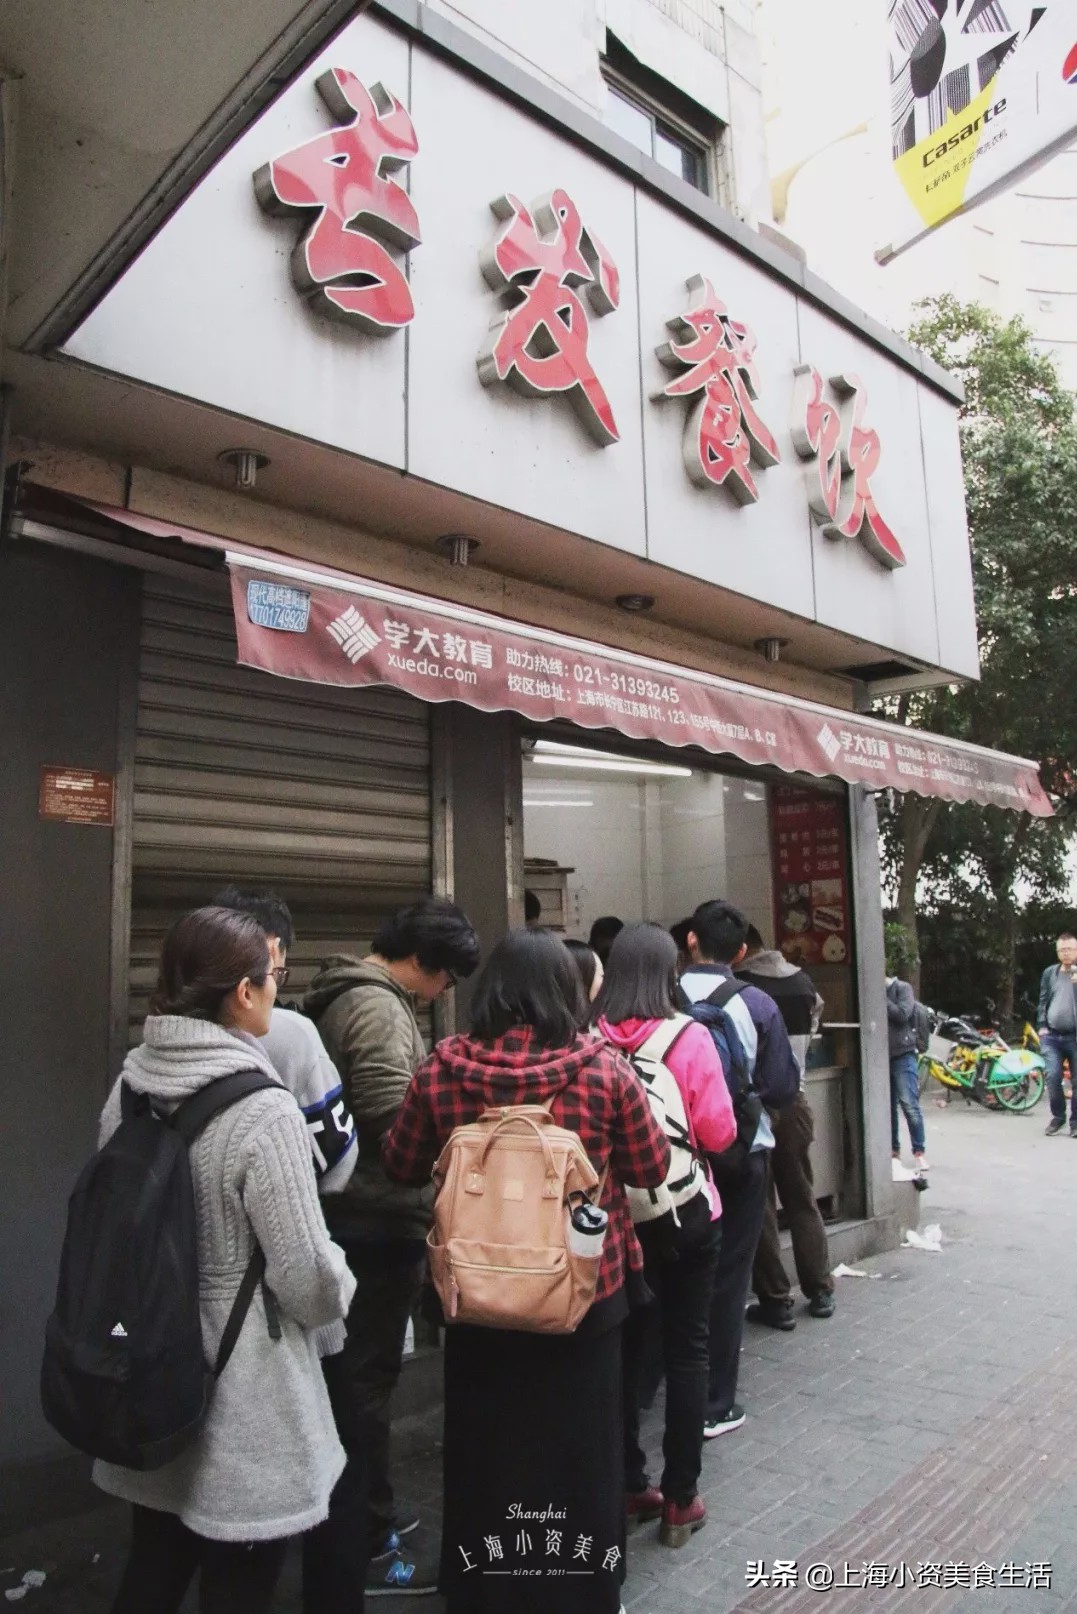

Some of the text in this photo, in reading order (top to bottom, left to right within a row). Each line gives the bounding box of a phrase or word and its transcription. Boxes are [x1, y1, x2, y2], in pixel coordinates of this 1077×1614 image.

[923, 98, 1007, 168] Casarte
[383, 619, 493, 668] 学大教育
[387, 652, 477, 684] xueda.com
[840, 730, 891, 760] 学大教育
